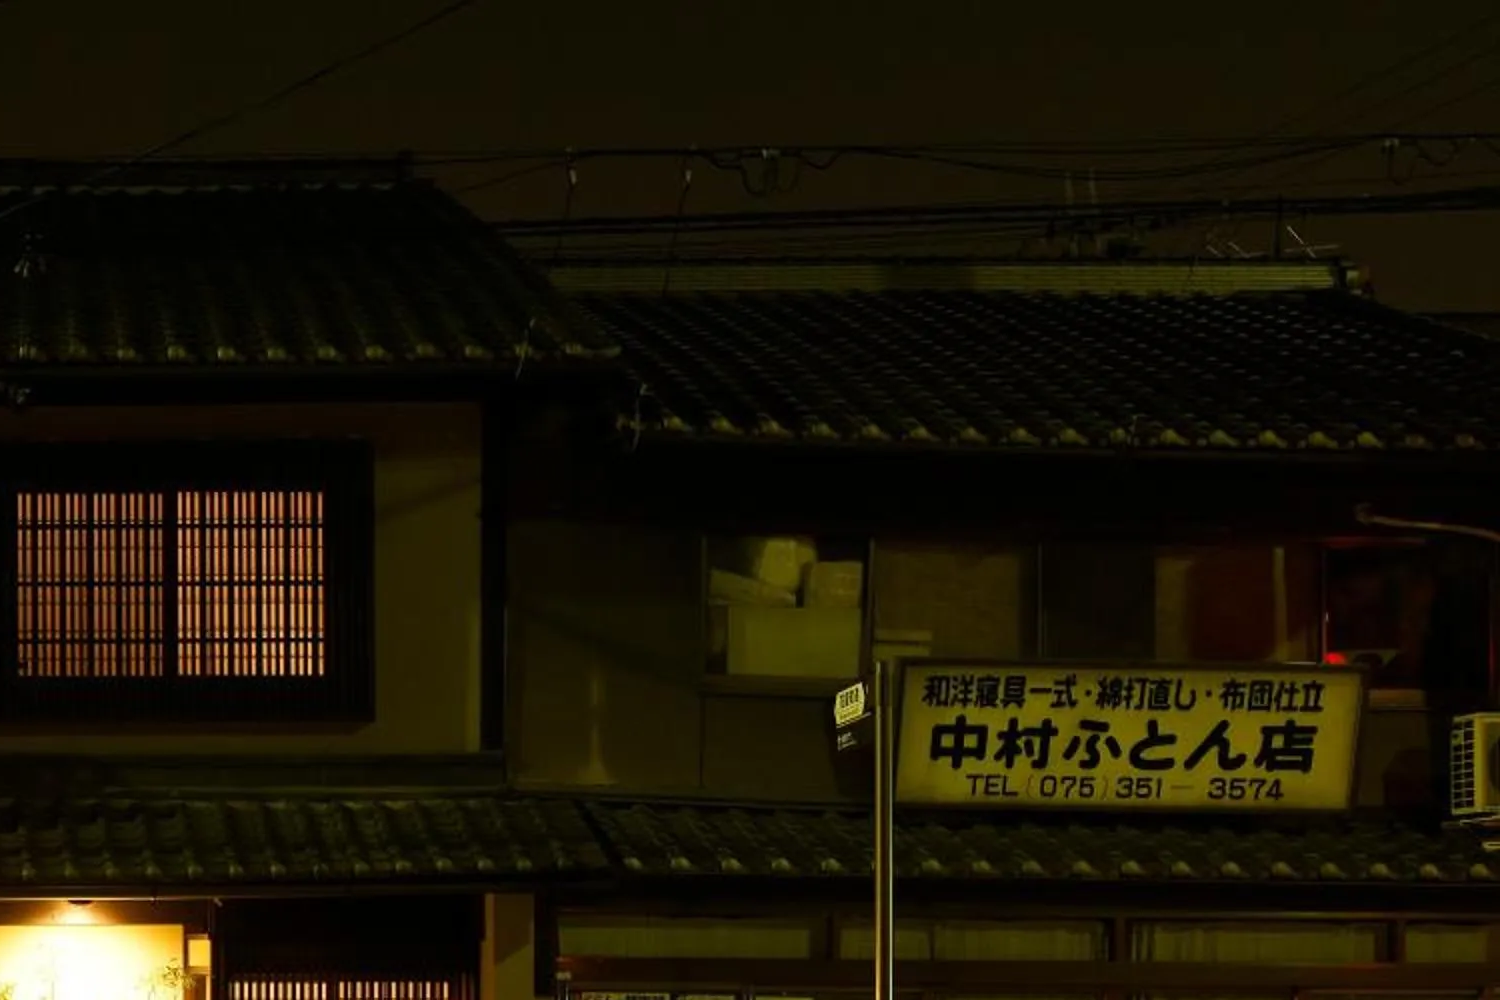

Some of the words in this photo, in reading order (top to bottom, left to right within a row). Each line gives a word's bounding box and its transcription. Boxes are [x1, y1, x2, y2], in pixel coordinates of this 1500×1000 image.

[929, 715, 1318, 773] 中村ふとん店
[966, 774, 1019, 798] TEL
